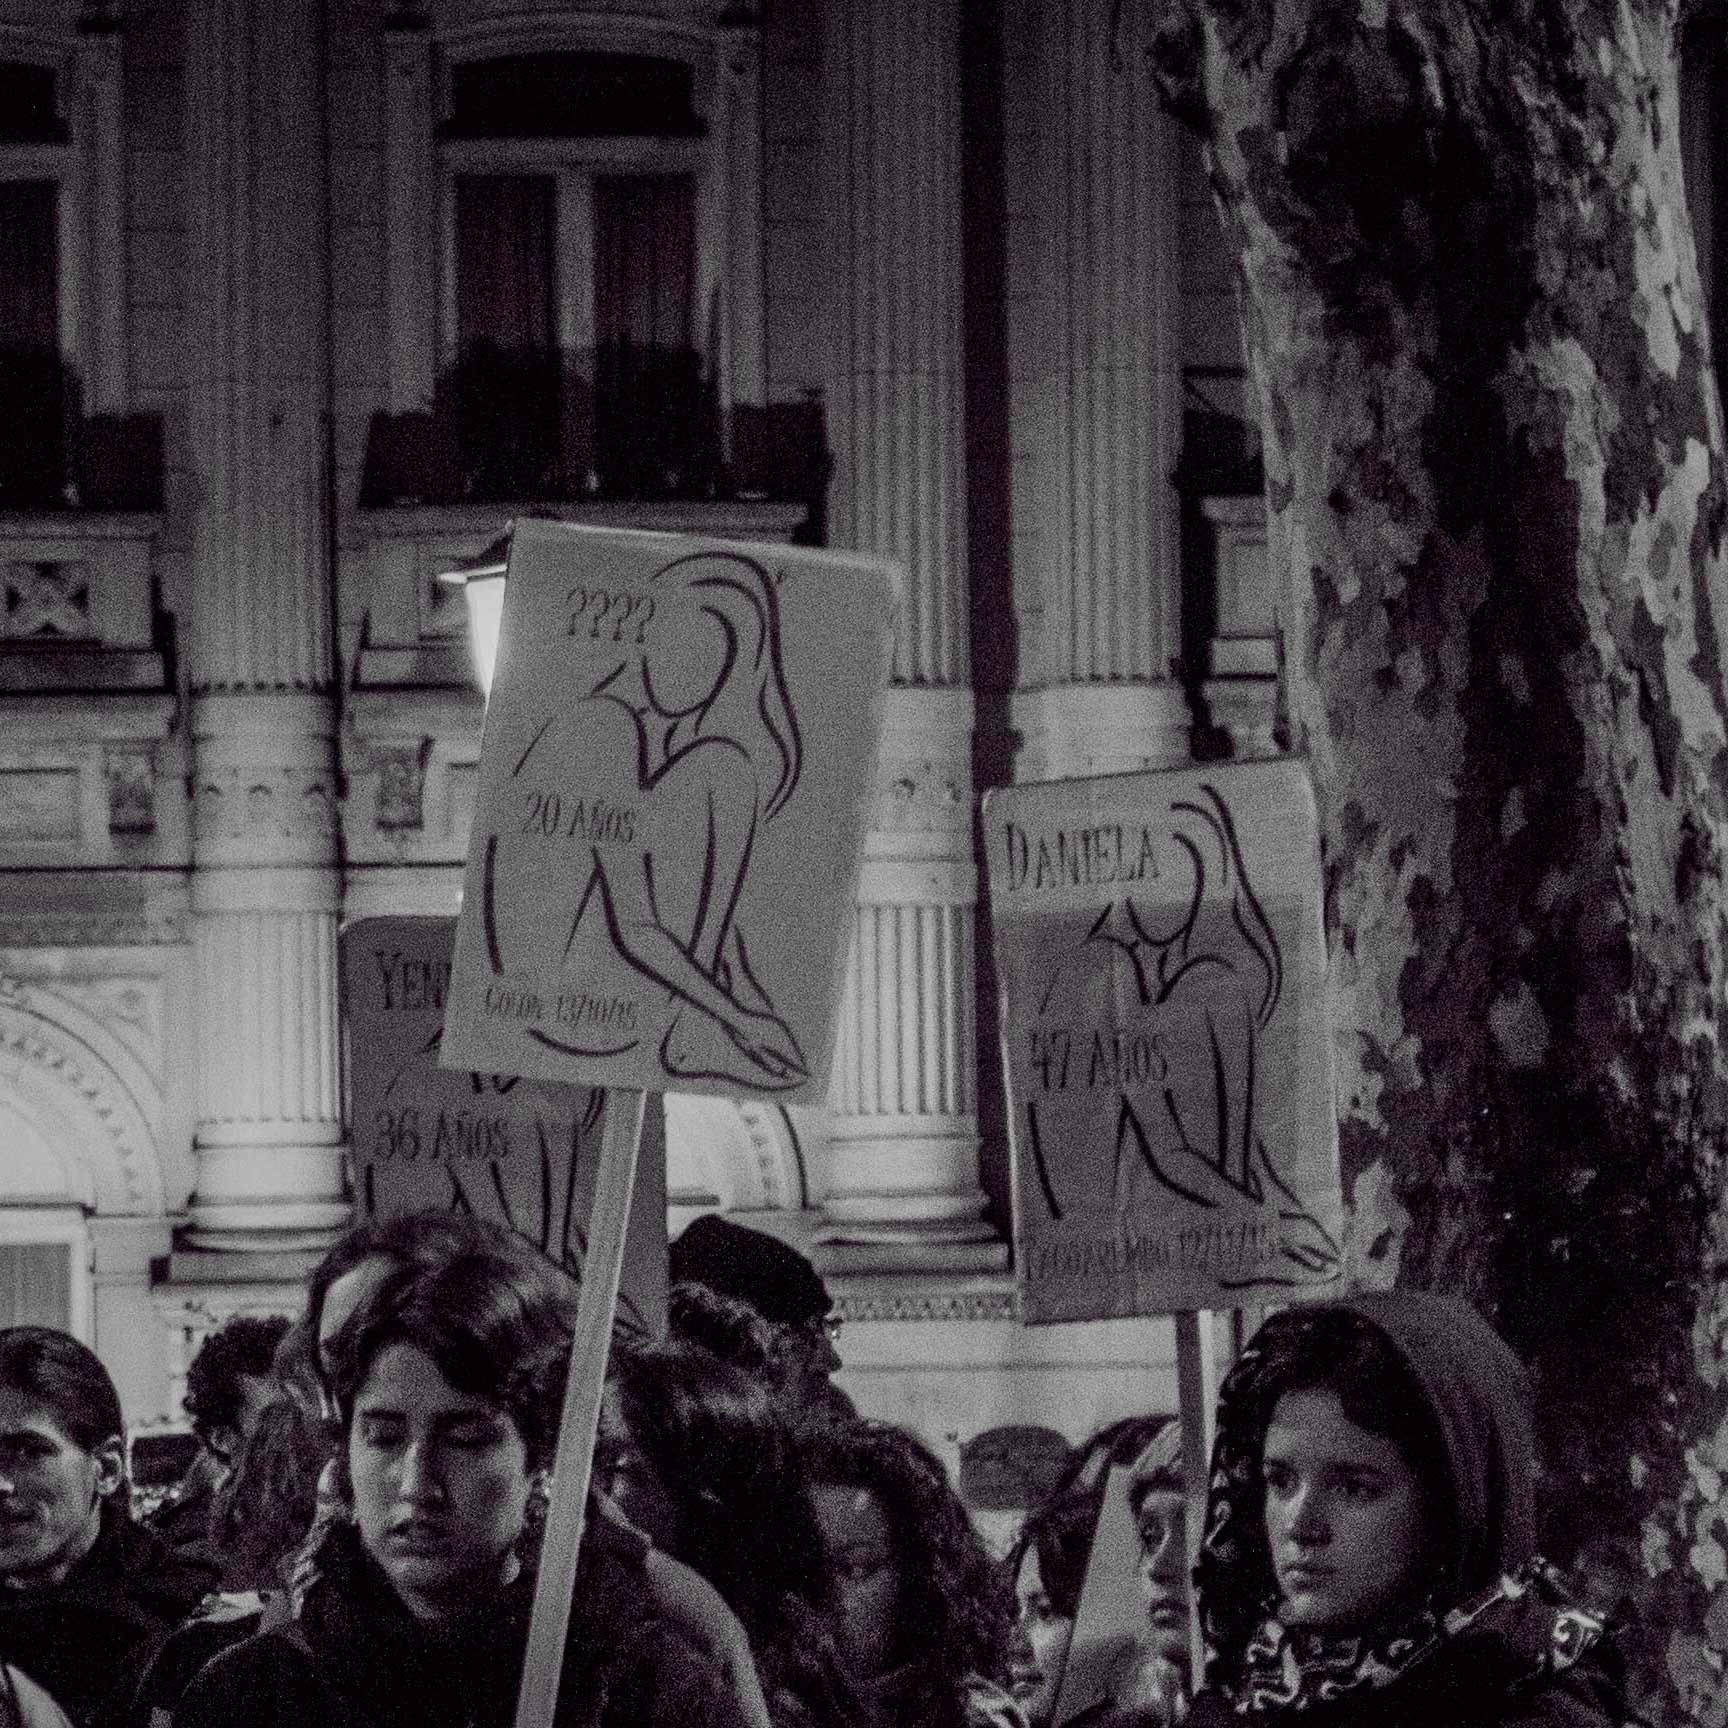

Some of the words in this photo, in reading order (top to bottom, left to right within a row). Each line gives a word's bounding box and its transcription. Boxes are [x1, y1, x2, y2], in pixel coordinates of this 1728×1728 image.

[523, 793, 561, 837] 20
[570, 797, 640, 845] AÑOS
[1003, 823, 1160, 893] DANIELA
[1029, 1029, 1072, 1090] 47
[374, 1106, 422, 1161] 36
[430, 1108, 511, 1161] AÑOS
